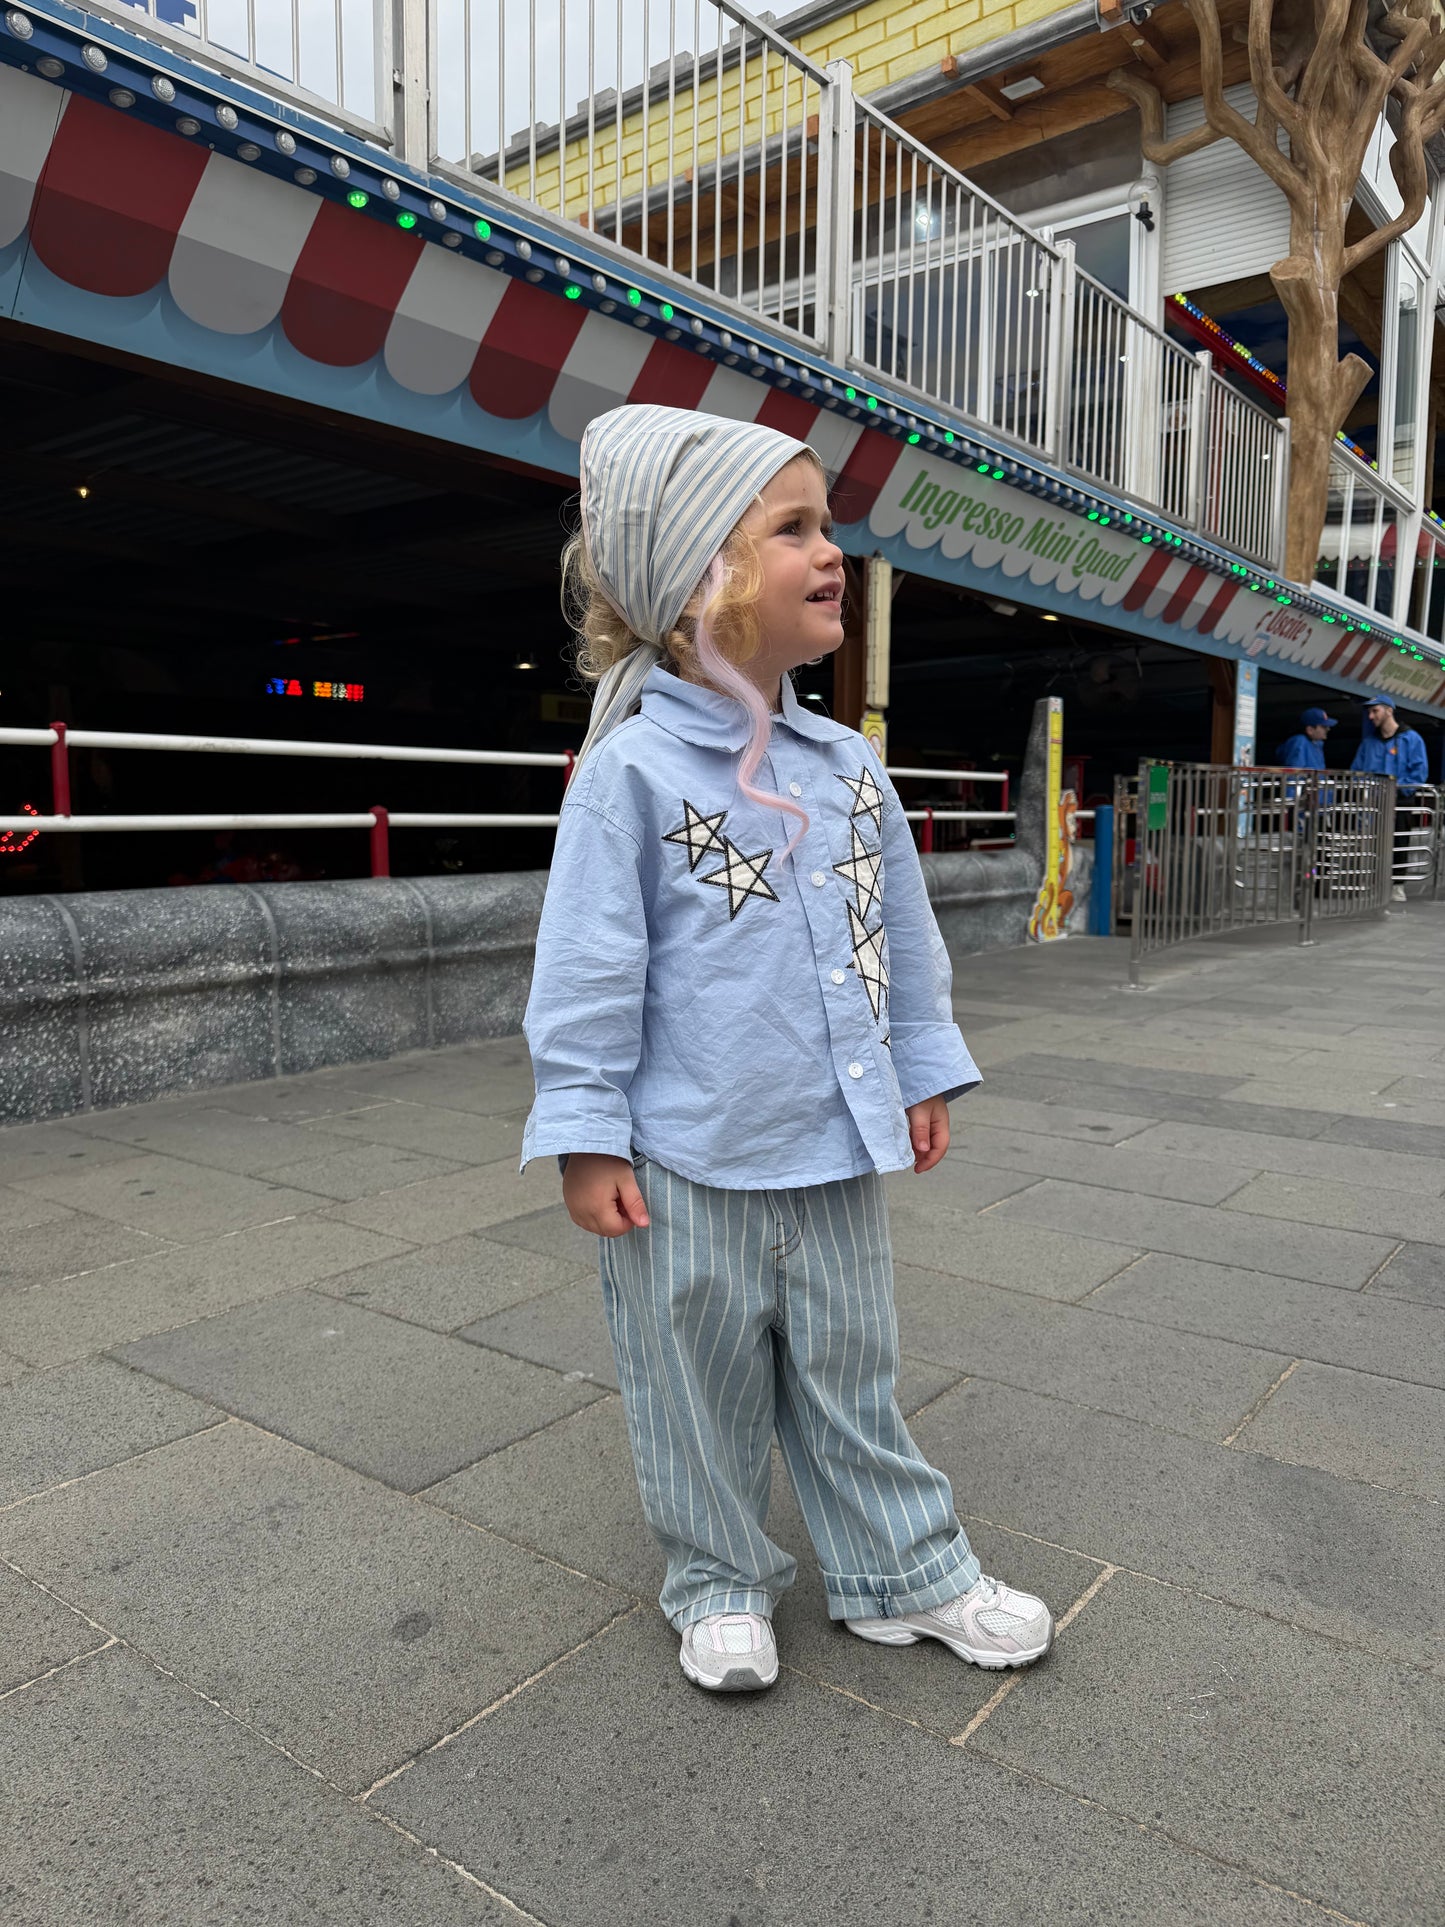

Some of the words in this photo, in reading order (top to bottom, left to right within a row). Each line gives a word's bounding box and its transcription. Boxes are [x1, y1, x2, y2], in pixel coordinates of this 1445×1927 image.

[897, 469, 1025, 545] Ingresso
[1019, 517, 1084, 564] Mini
[1071, 537, 1138, 583] Quad
